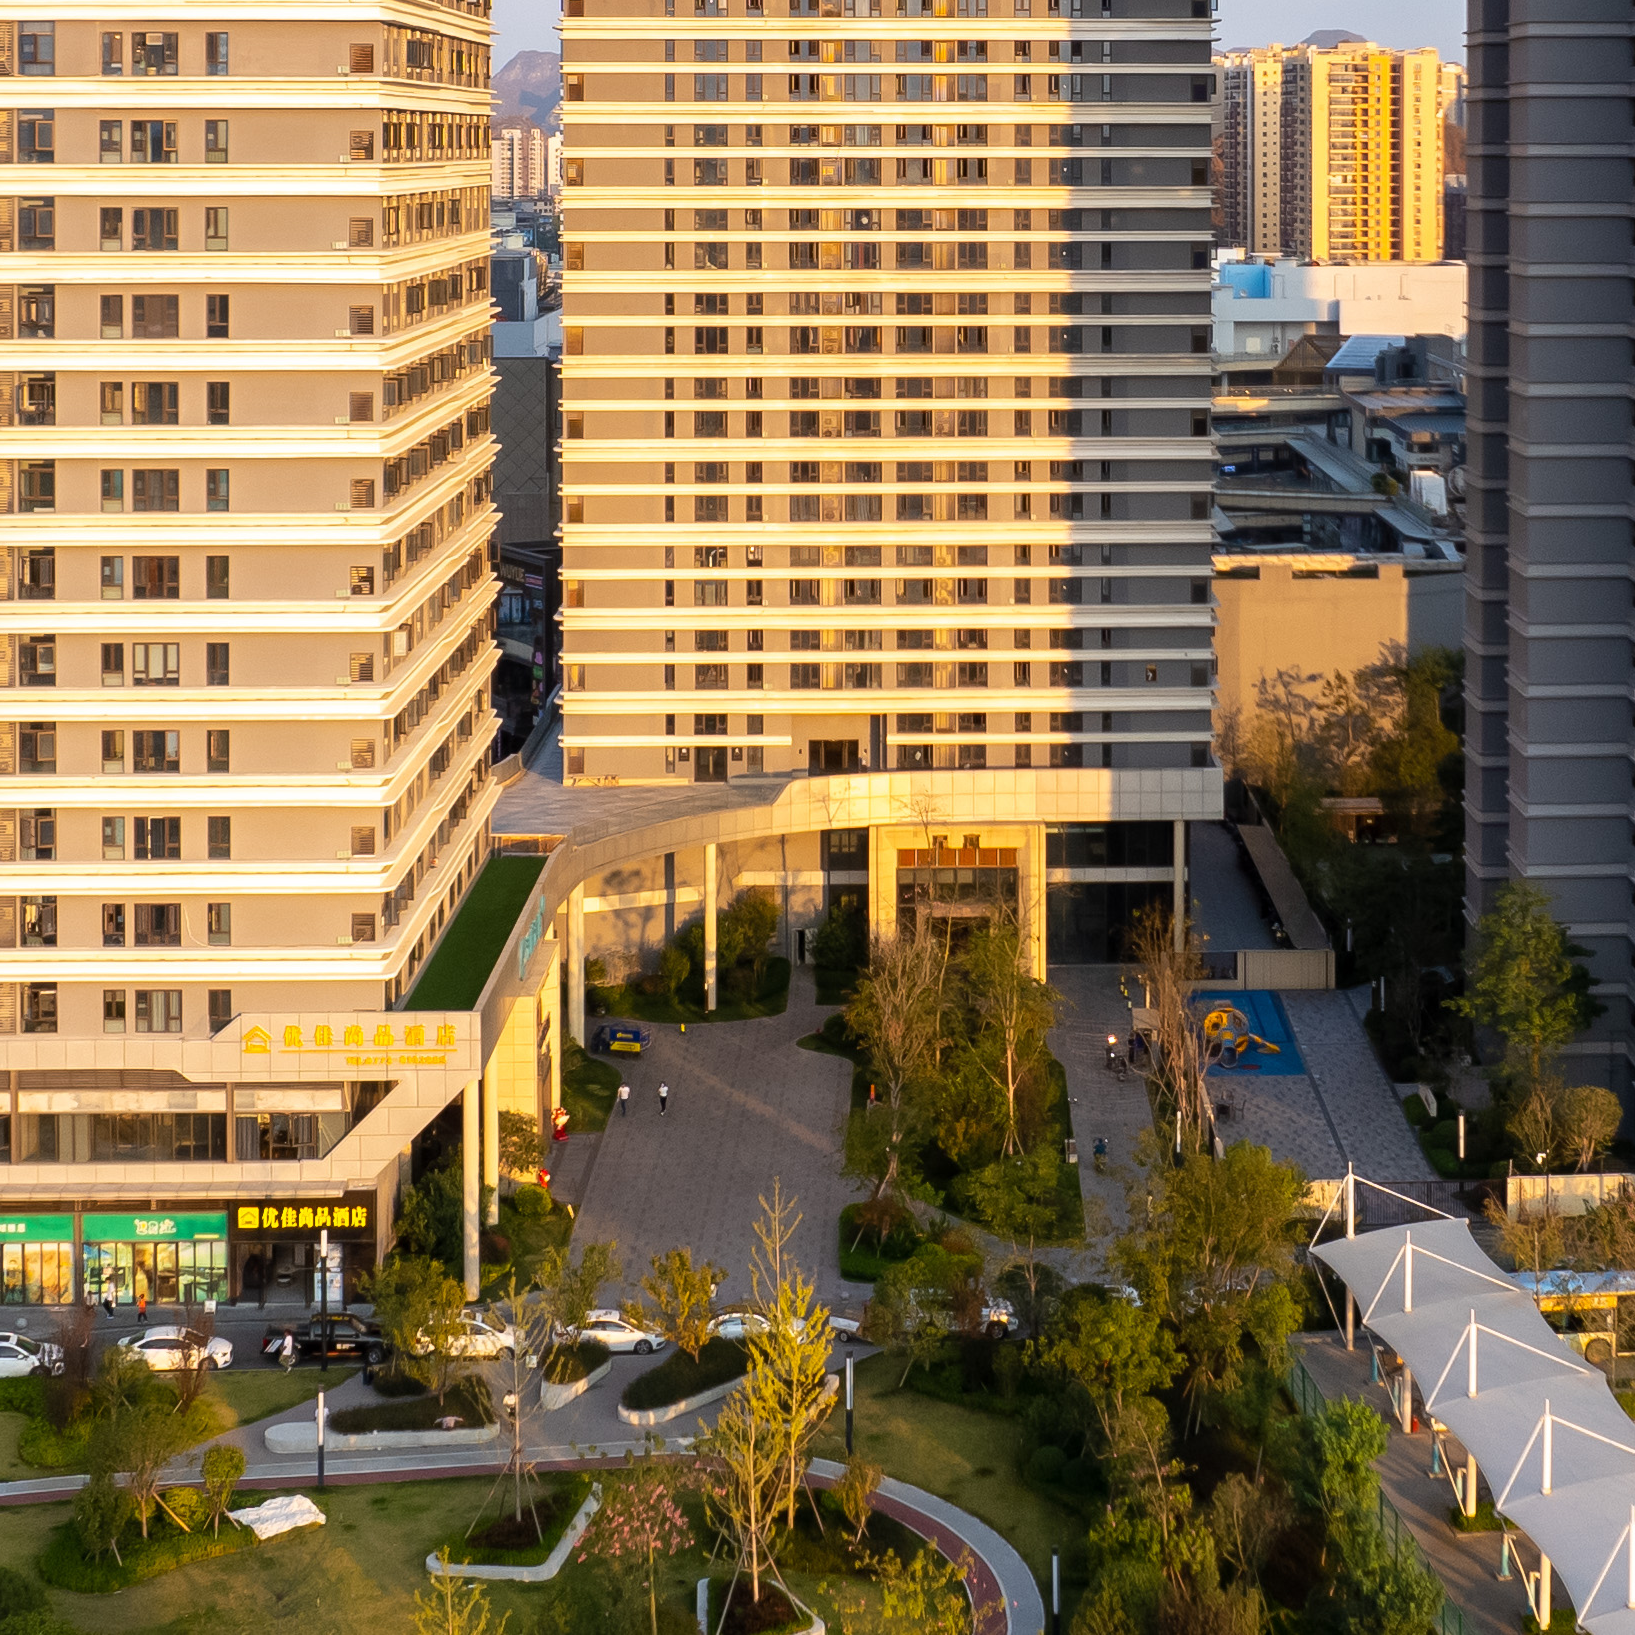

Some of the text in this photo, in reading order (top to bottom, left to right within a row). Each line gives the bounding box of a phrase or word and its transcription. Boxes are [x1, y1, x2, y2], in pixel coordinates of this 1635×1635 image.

[283, 1024, 457, 1047] 优佳尚品酒店
[262, 1206, 367, 1228] 优佳尚品酒店
